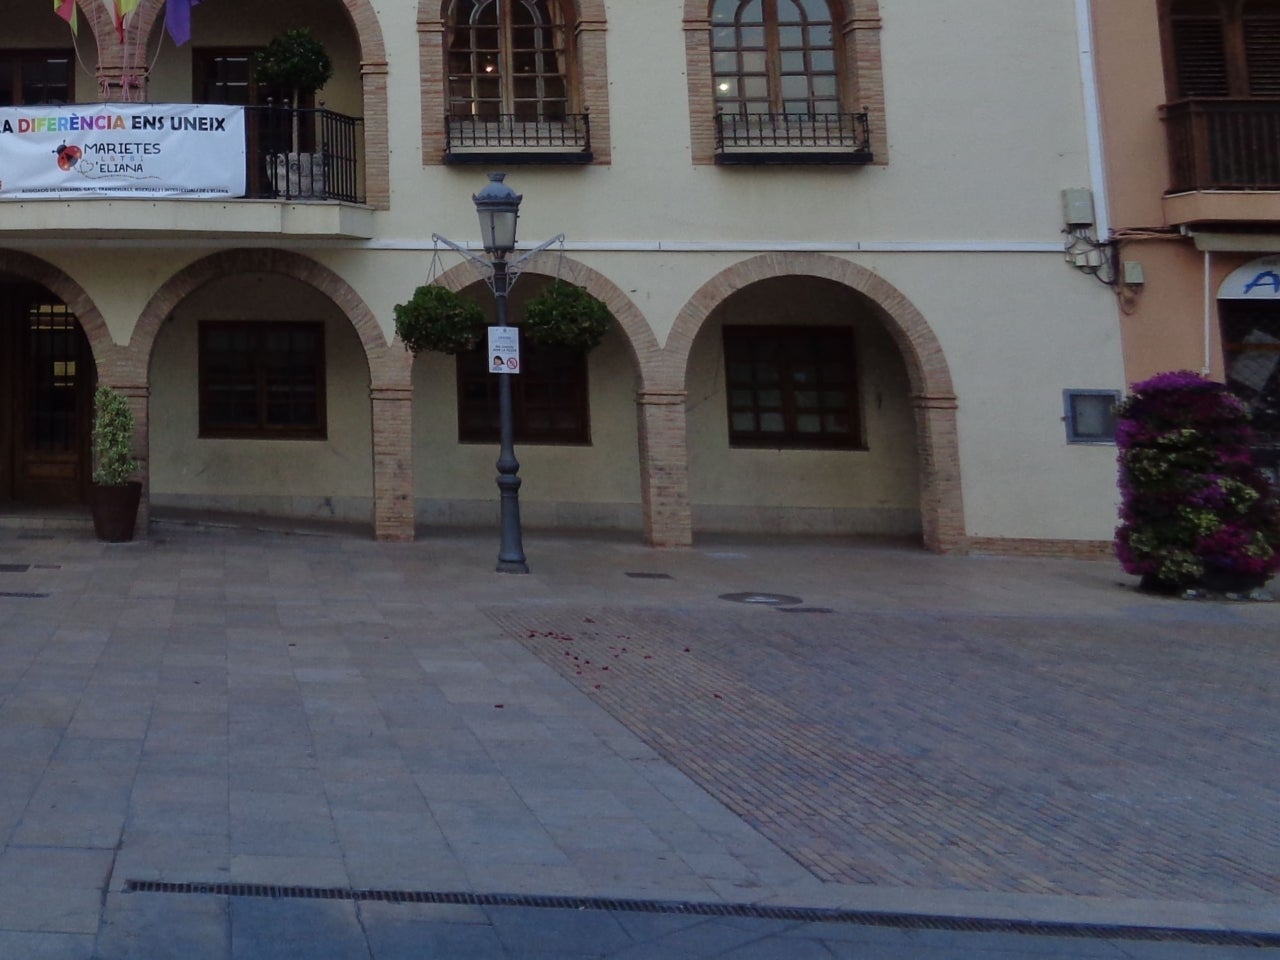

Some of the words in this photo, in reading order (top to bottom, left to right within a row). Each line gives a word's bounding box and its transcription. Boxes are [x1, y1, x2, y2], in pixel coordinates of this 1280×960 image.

[18, 113, 126, 133] DIFERÈNCIA
[131, 115, 165, 131] ENS
[170, 116, 226, 132] UNEIX
[84, 142, 161, 155] MARIETES
